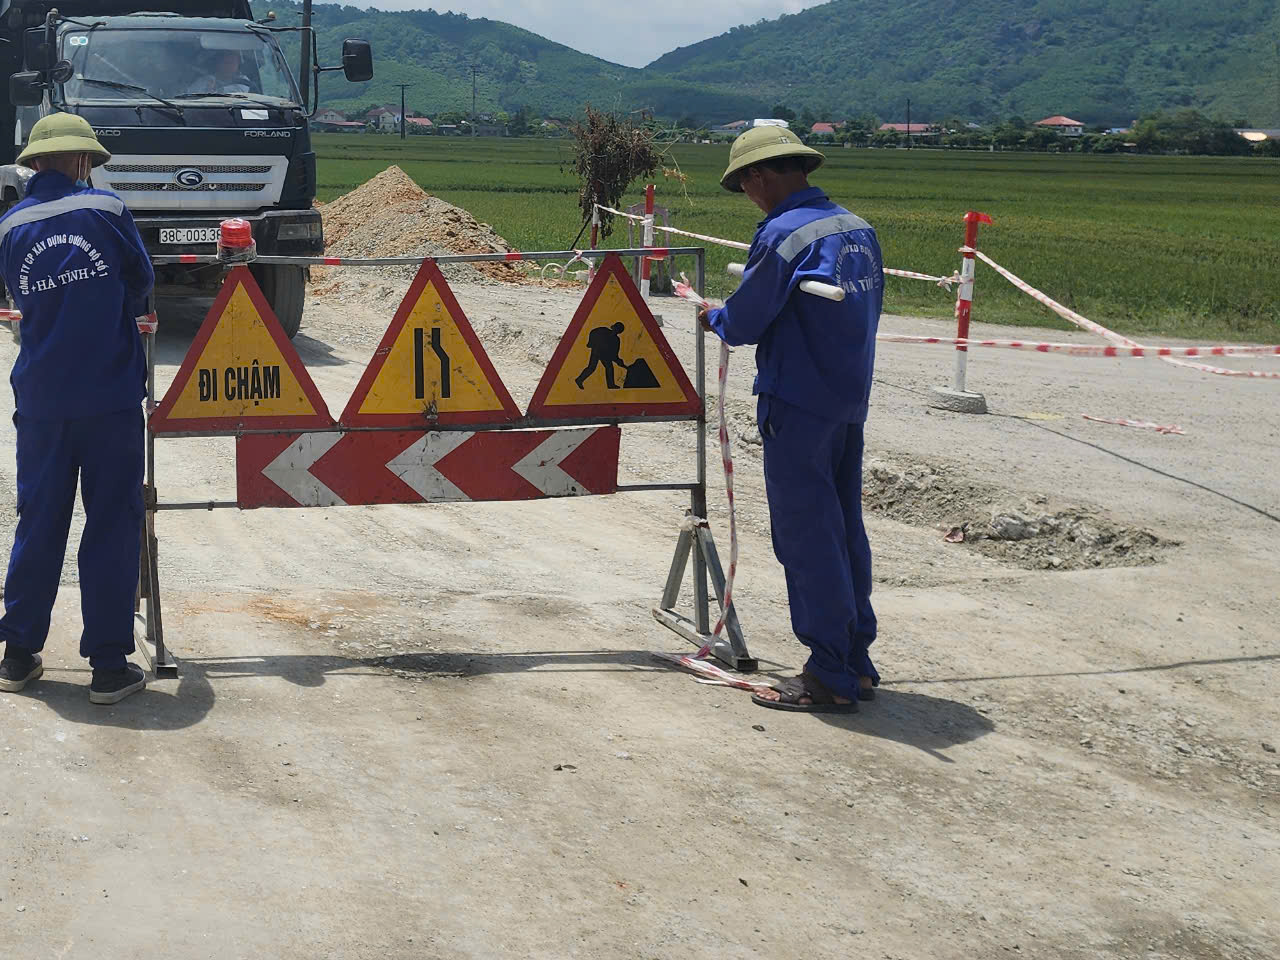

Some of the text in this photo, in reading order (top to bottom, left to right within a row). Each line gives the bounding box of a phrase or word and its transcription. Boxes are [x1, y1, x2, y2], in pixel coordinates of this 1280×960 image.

[244, 130, 291, 138] FORLAND
[32, 240, 47, 256] XÂY
[46, 234, 67, 248] DỰNG
[68, 234, 92, 252] ĐƯỜNG
[24, 253, 35, 264] CP
[88, 248, 102, 262] BỘ
[20, 264, 31, 274] TY
[95, 260, 110, 272] SỐ
[19, 274, 30, 295] CÔNG
[36, 268, 89, 292] HÀ TĨNH
[198, 359, 280, 406] ĐI CHẬM
